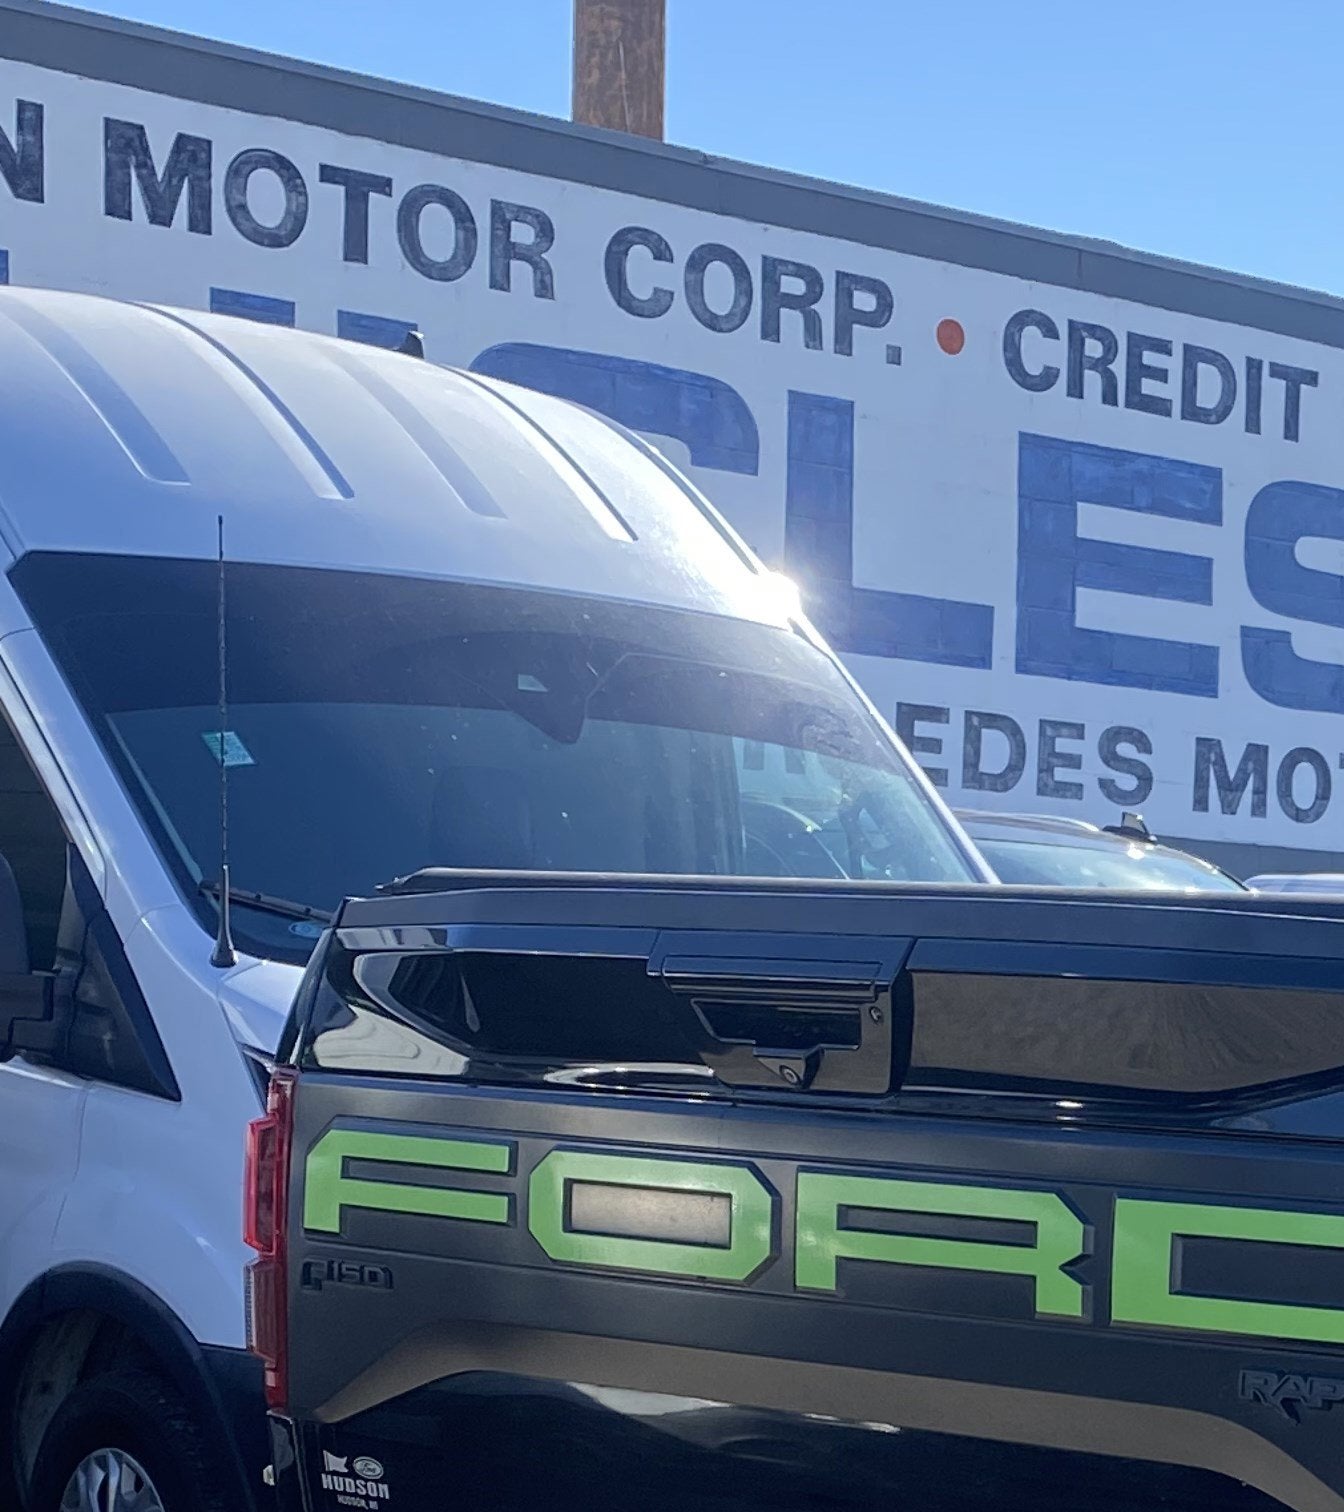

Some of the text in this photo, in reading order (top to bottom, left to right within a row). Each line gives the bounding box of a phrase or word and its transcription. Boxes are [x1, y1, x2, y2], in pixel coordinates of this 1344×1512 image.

[103, 117, 557, 302] MOTOR
[605, 226, 903, 367] CORP.
[1002, 308, 1319, 443] CREDIT
[895, 702, 1154, 807] EDES
[321, 1473, 390, 1500] HUDSON
